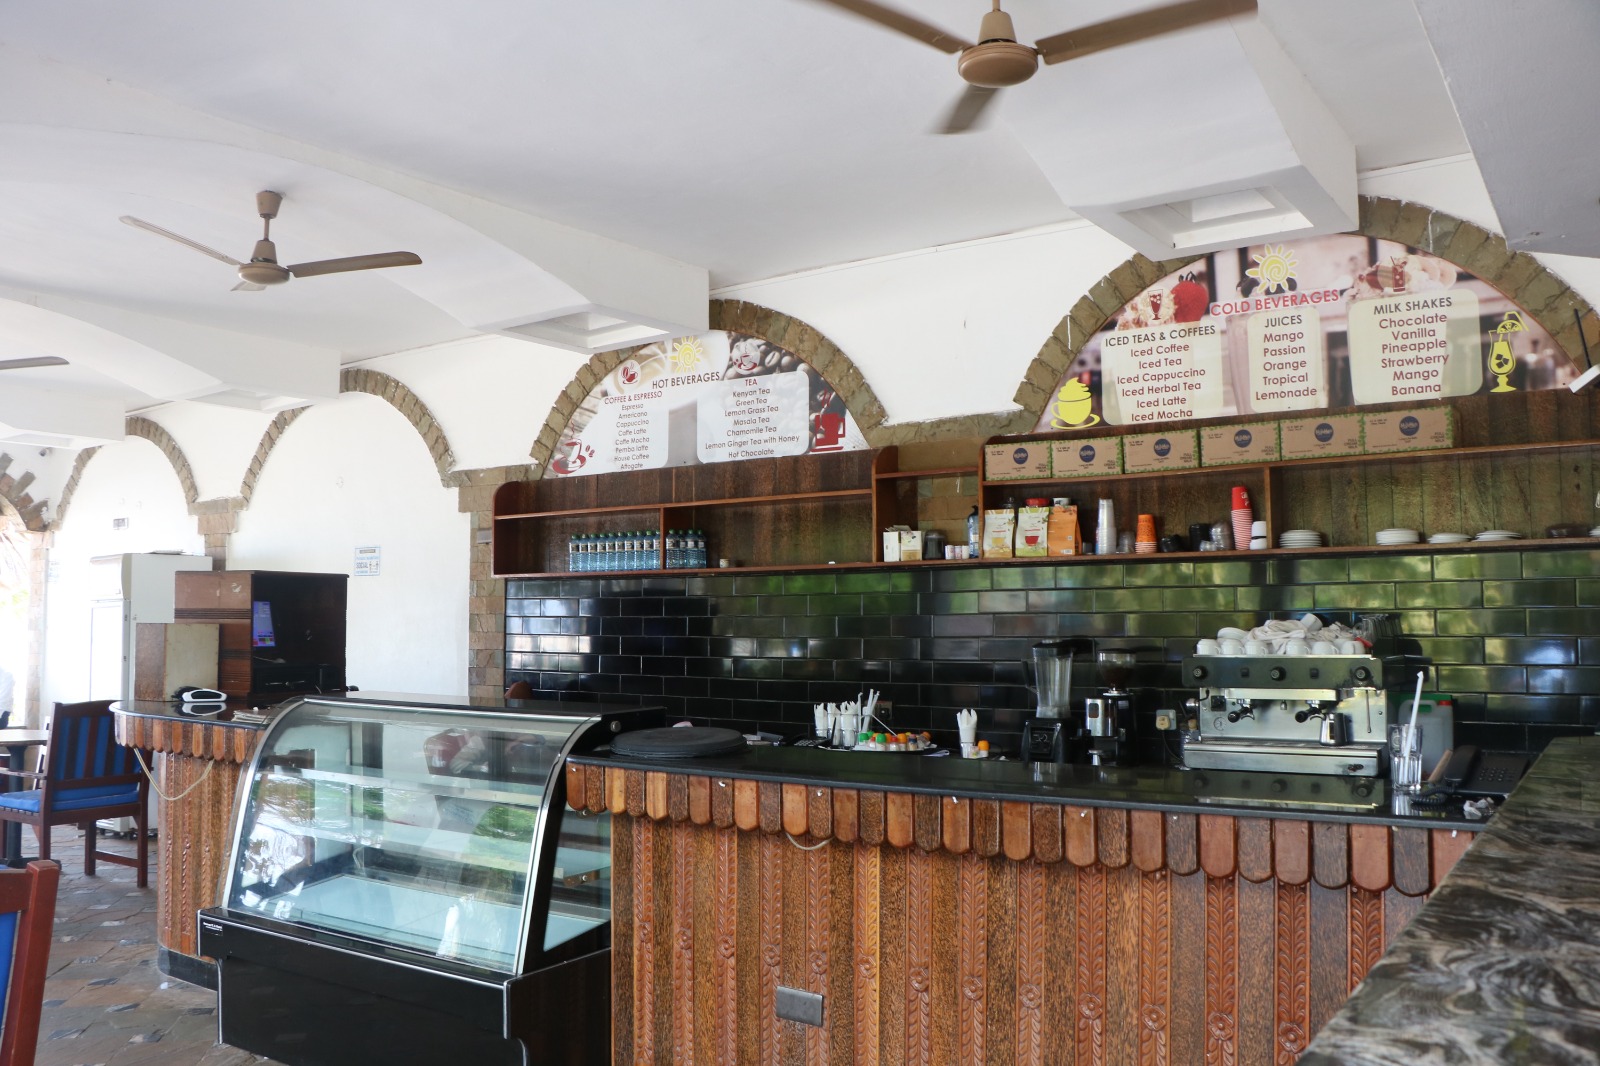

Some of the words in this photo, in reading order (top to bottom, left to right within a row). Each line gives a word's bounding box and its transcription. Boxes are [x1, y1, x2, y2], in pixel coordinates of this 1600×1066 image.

[1210, 300, 1251, 316] COLD
[1256, 289, 1339, 311] BEVERAGES
[1373, 302, 1401, 315] MILK
[1406, 297, 1452, 310] SHAKES
[1264, 314, 1303, 328] JUICES
[1379, 313, 1448, 329] Chocolate
[1105, 336, 1129, 347] ICED
[1132, 332, 1156, 343] TEAS
[1160, 332, 1166, 340] &
[1170, 325, 1216, 338] COFFEES
[1263, 331, 1305, 343] Mango
[1391, 328, 1436, 341] Vanilla
[1130, 348, 1153, 358] Iced
[1156, 343, 1190, 354] Coffee
[1263, 345, 1305, 358] Passion
[1381, 339, 1447, 354] Pineapple
[1138, 360, 1161, 369] Iced
[1164, 357, 1182, 367] Tea
[1263, 360, 1307, 371] Orange
[1381, 354, 1449, 369] Strawberry
[652, 379, 668, 389] HOT
[671, 372, 720, 386] BEVERAGES
[1117, 375, 1140, 384] Iced
[1142, 368, 1206, 382] Cappuccino
[1263, 373, 1308, 386] Tropical
[1393, 369, 1438, 381] Mango
[733, 390, 757, 398] Kenyan
[1122, 387, 1145, 397] Iced
[1147, 384, 1181, 394] Herbal
[1182, 382, 1202, 391] Tea
[1255, 387, 1317, 400] Lemonade
[1391, 384, 1441, 396] Banana
[604, 395, 627, 404] COFFEE
[634, 391, 662, 401] ESPRESSO
[1137, 398, 1159, 407] Iced
[1162, 396, 1187, 406] Latte
[618, 411, 647, 419] Americano
[725, 409, 746, 417] Lemon
[1131, 412, 1154, 422] Iced
[1157, 409, 1193, 420] Mocha
[616, 419, 649, 428] Cappuccino
[734, 418, 756, 426] Masala
[727, 428, 763, 436] Chamomile
[631, 436, 649, 444] Mocha
[706, 442, 725, 450] Lemon
[728, 440, 749, 449] Ginger
[779, 435, 800, 444] Honey
[729, 450, 739, 458] Hot
[741, 448, 774, 457] Chocolate
